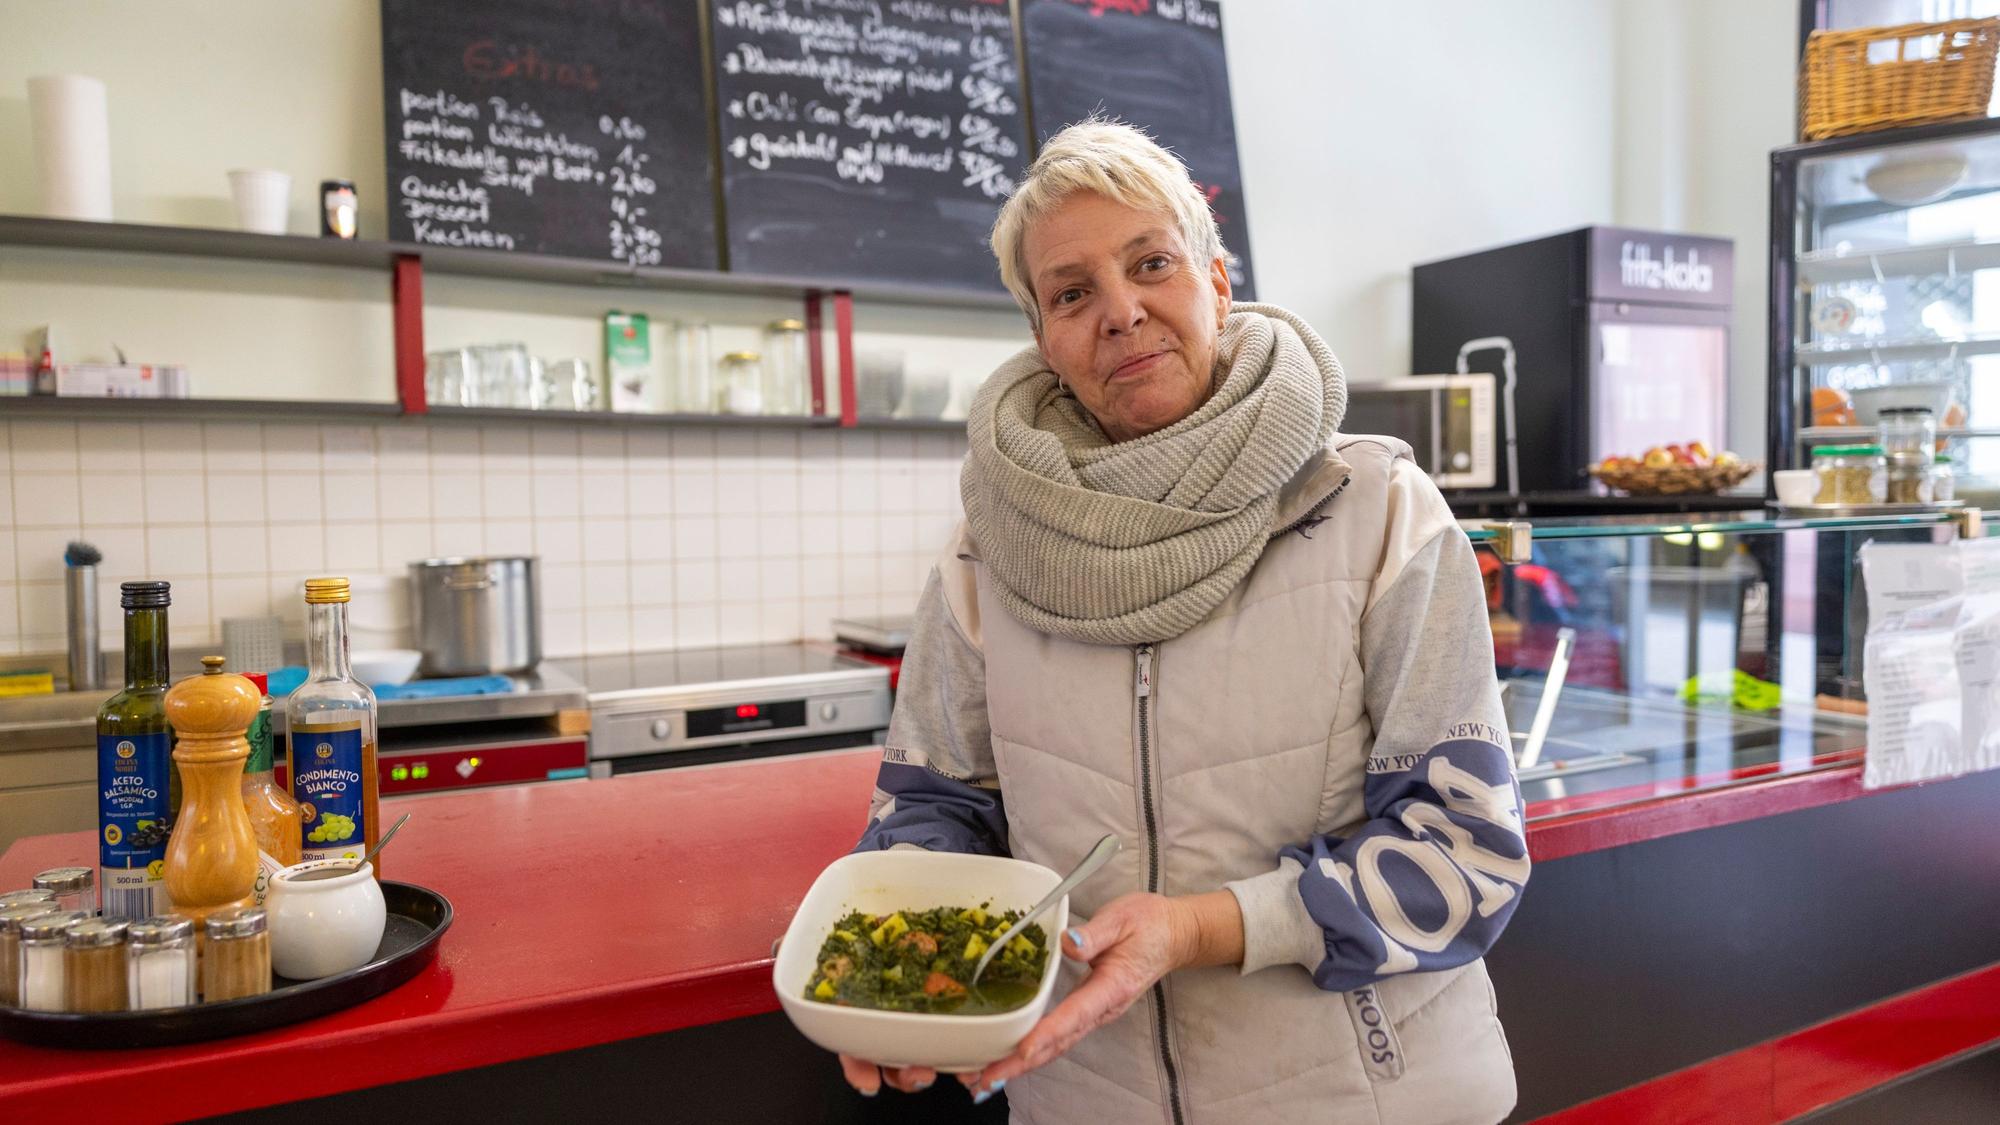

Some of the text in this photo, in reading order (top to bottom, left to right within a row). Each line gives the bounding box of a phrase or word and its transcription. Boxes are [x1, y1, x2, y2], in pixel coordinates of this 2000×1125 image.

[1620, 239, 1713, 293] fritz-kola
[1446, 722, 1484, 740] NEW
[1367, 758, 1391, 772] EW
[112, 776, 144, 786] ACETO
[295, 769, 360, 786] CONDIMENTO
[104, 787, 158, 800] BALSAMICO
[305, 781, 347, 794] BIANCO
[1353, 988, 1395, 1064] ROOS
